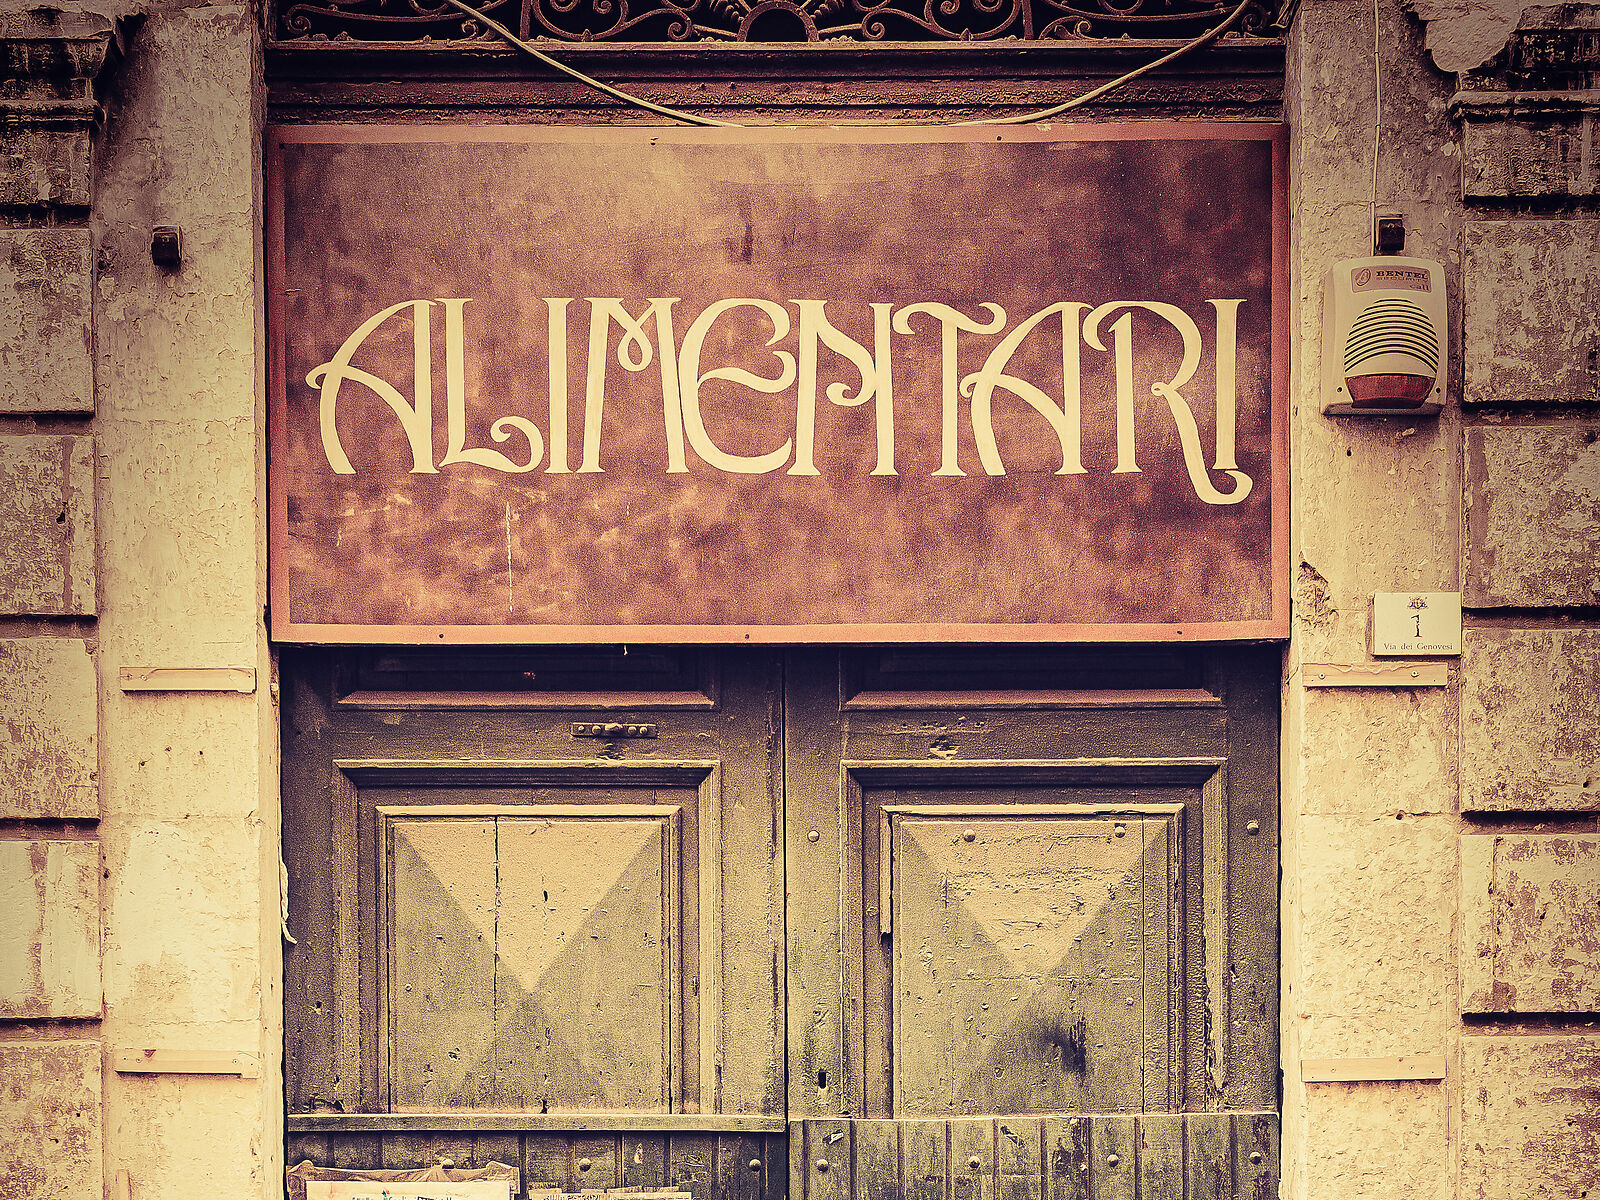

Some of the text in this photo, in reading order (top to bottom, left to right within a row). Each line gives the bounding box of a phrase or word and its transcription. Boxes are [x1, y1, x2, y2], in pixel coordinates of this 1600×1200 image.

[1375, 270, 1429, 280] BENTEL
[304, 296, 1253, 505] ALIMENTARI
[1410, 614, 1424, 638] 1
[1383, 642, 1453, 650] Via dei Genovesi
